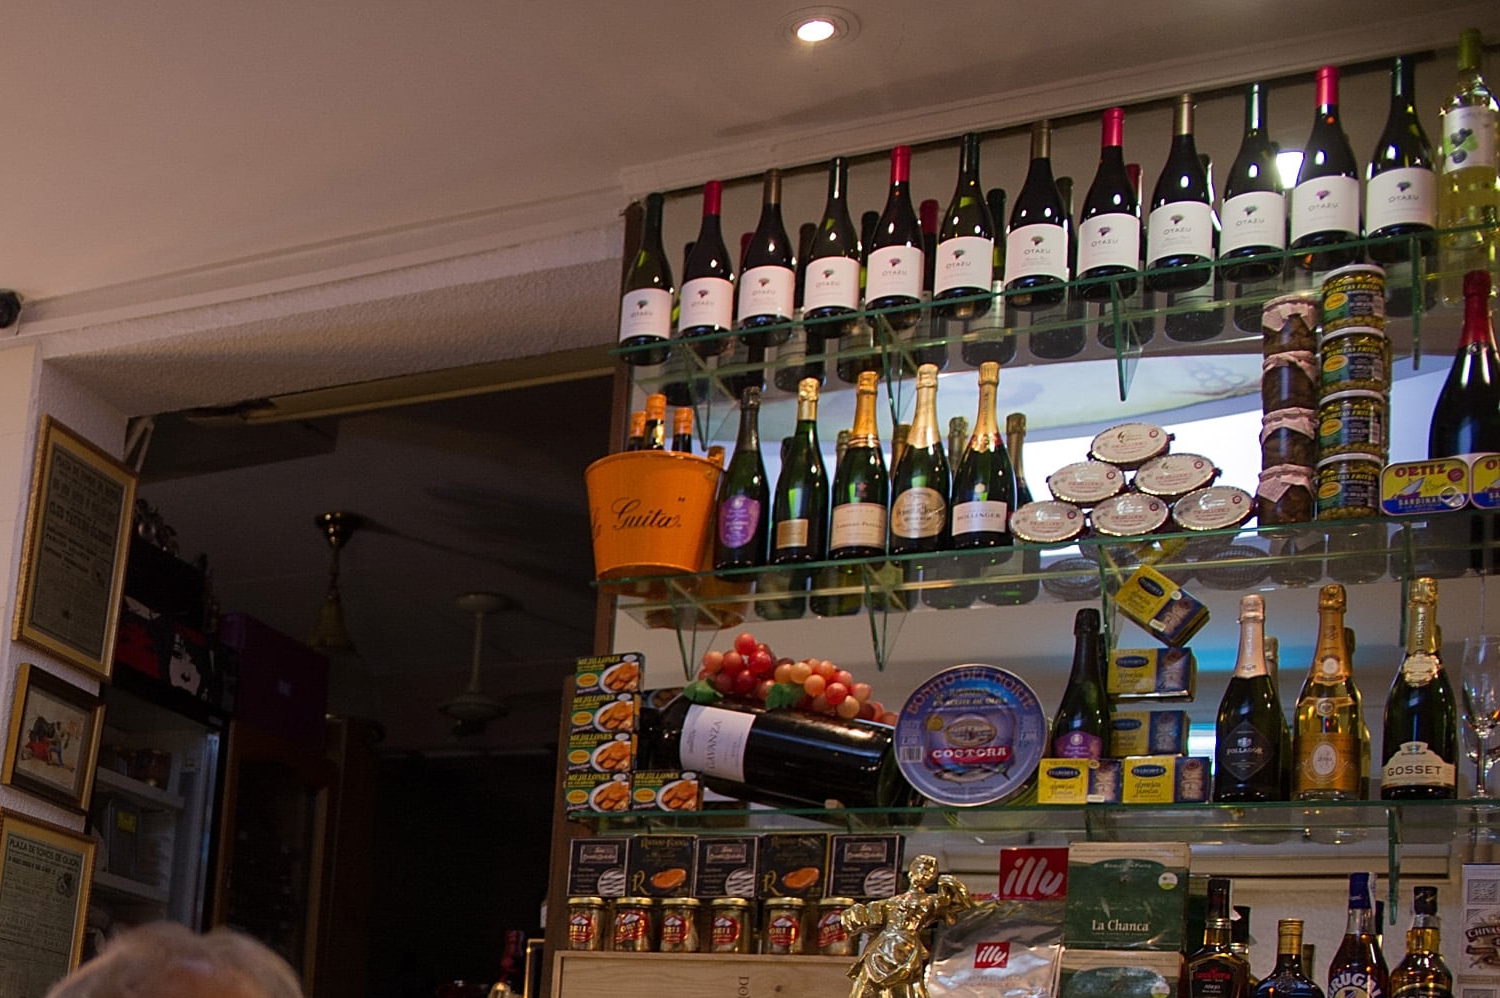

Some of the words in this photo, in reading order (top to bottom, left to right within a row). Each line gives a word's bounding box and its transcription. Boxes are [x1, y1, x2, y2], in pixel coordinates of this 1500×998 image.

[1388, 194, 1419, 202] OTAZU
[1308, 202, 1339, 212] OTAZU
[1235, 218, 1264, 226] OTAZU
[1163, 227, 1191, 236] OTAZU
[1092, 238, 1118, 248] OTAZU
[815, 281, 841, 289] OTAZU
[751, 288, 776, 296] OTAZU
[1394, 464, 1446, 478] ORTIZ
[1416, 610, 1428, 647] GOSSET
[578, 656, 620, 665] MEJILLONES
[906, 672, 956, 715] BONITO
[961, 670, 989, 682] DEL
[993, 672, 1036, 711] NORTE
[573, 694, 616, 704] MEJILLONES
[570, 732, 613, 742] MEJILLONES
[634, 772, 680, 780] MEJILLONES
[1388, 764, 1443, 778] GOSSET
[568, 772, 611, 782] MEJILLONES
[10, 838, 27, 851] PLAZA
[28, 844, 34, 852] DE
[35, 846, 54, 860] TOROS
[54, 852, 62, 862] DE
[1003, 856, 1064, 896] illy
[1092, 920, 1107, 932] La
[1108, 920, 1150, 932] Chanca
[976, 946, 1008, 966] illy
